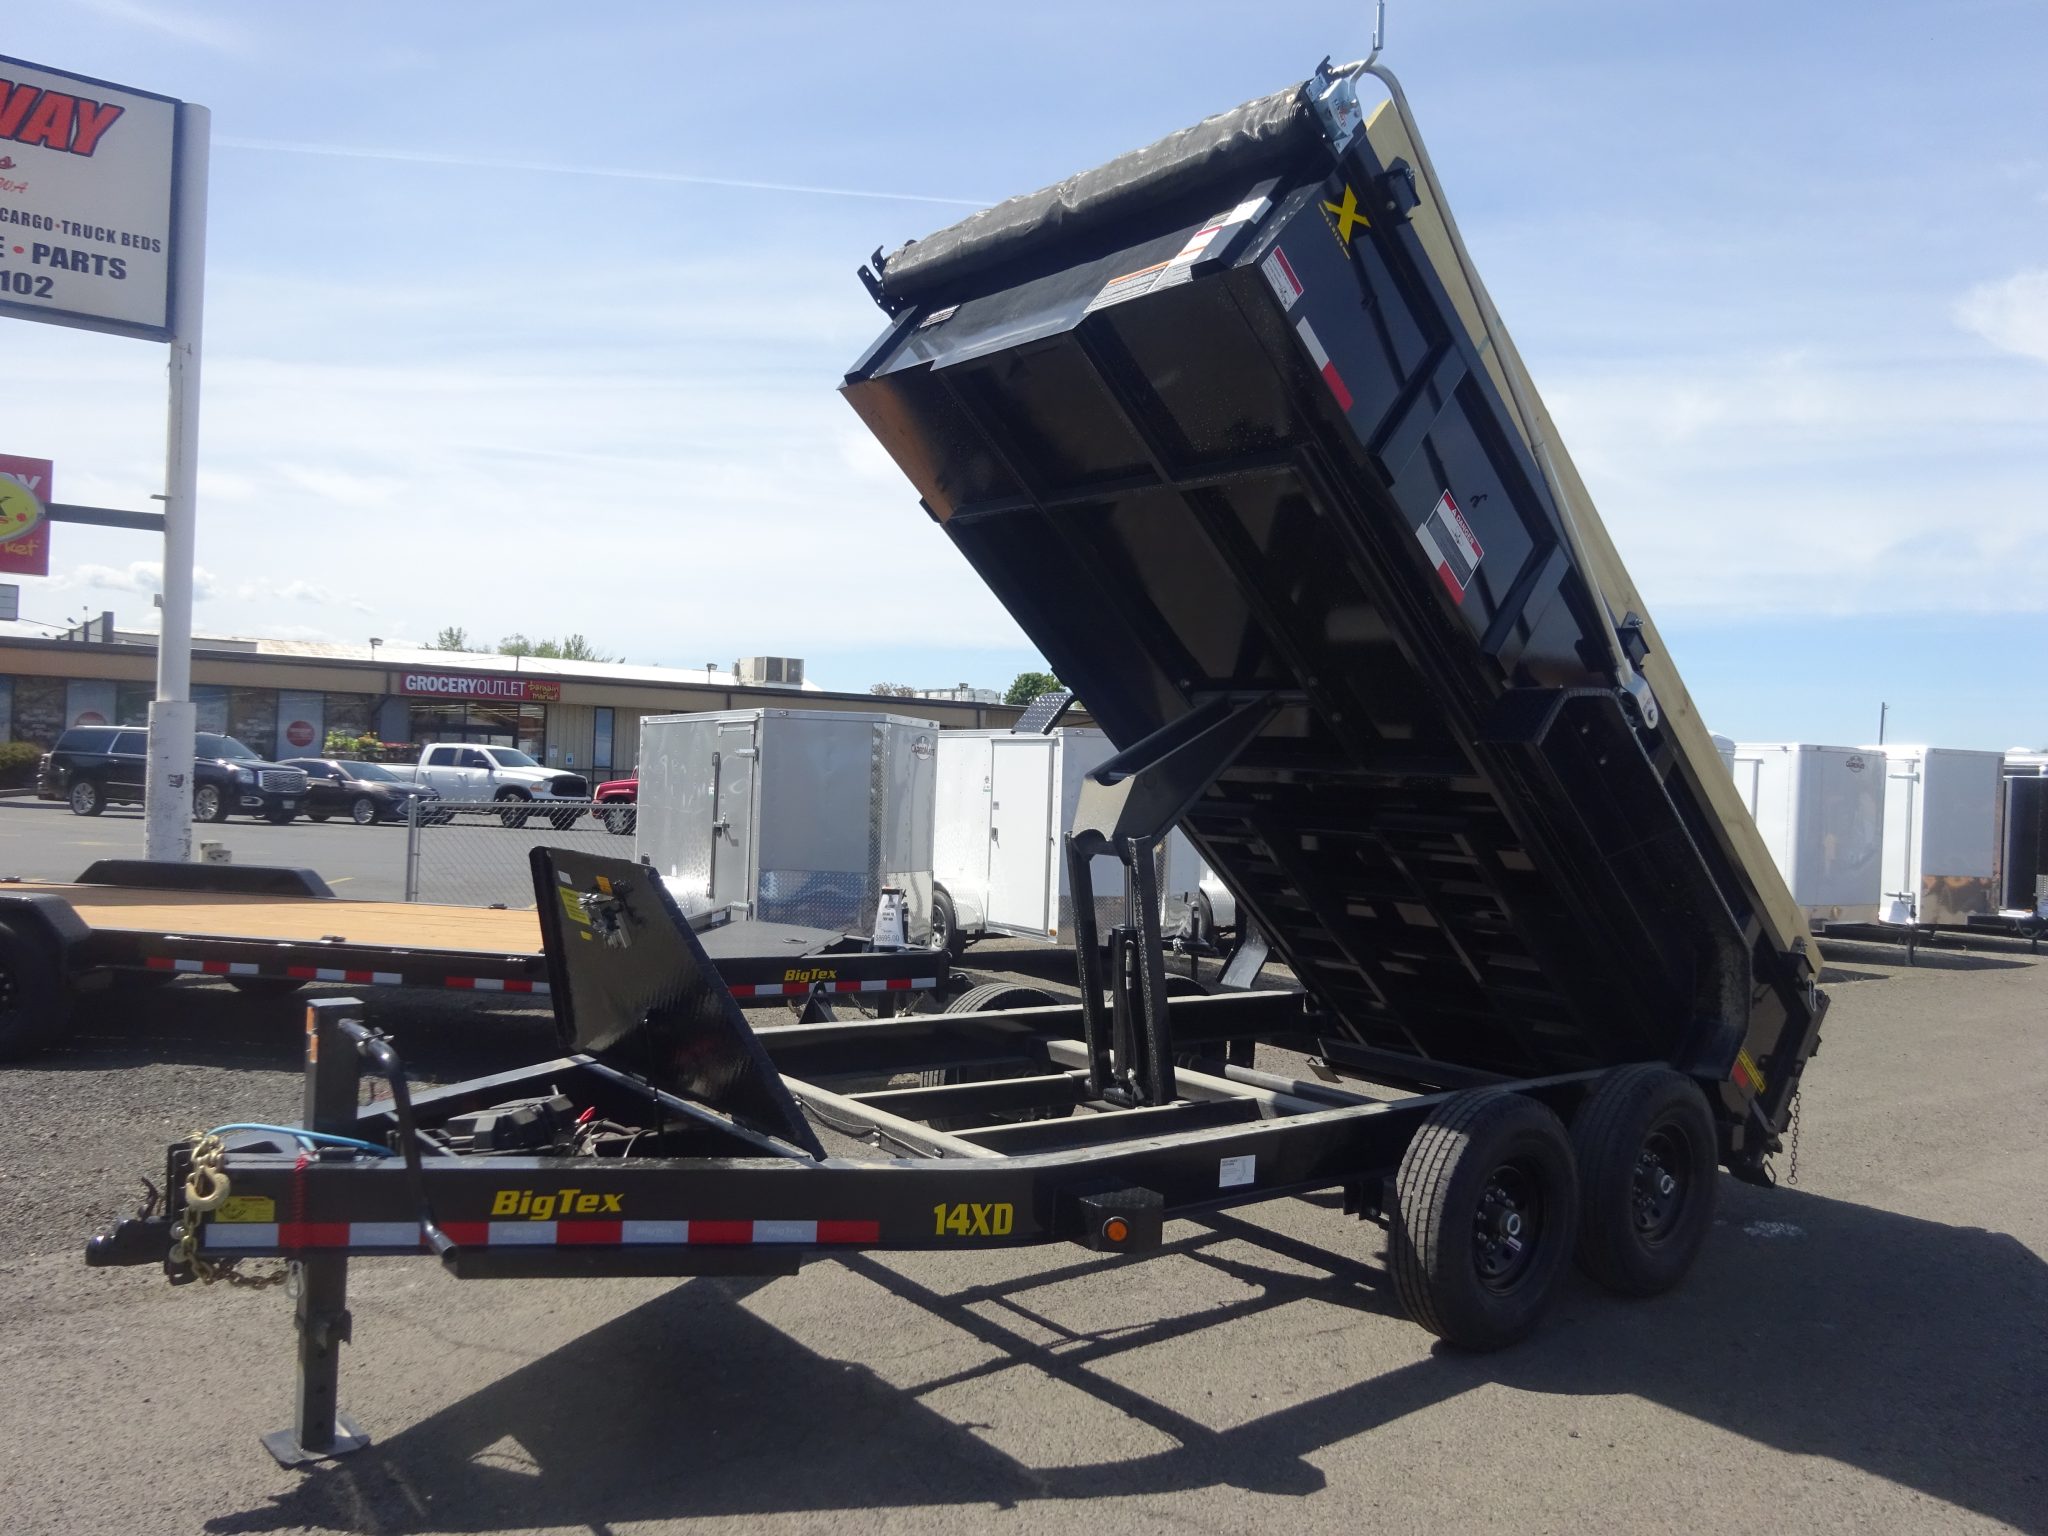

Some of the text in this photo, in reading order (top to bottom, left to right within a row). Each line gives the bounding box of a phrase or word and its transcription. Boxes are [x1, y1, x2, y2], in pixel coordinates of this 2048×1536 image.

[61, 220, 117, 244] TRUCK
[121, 232, 161, 253] BEDS
[32, 242, 127, 280] PARTS
[1456, 514, 1475, 544] DANGER
[784, 968, 837, 982] BigTex
[490, 1189, 624, 1220] BigTex
[934, 1203, 1014, 1236] 14XD
